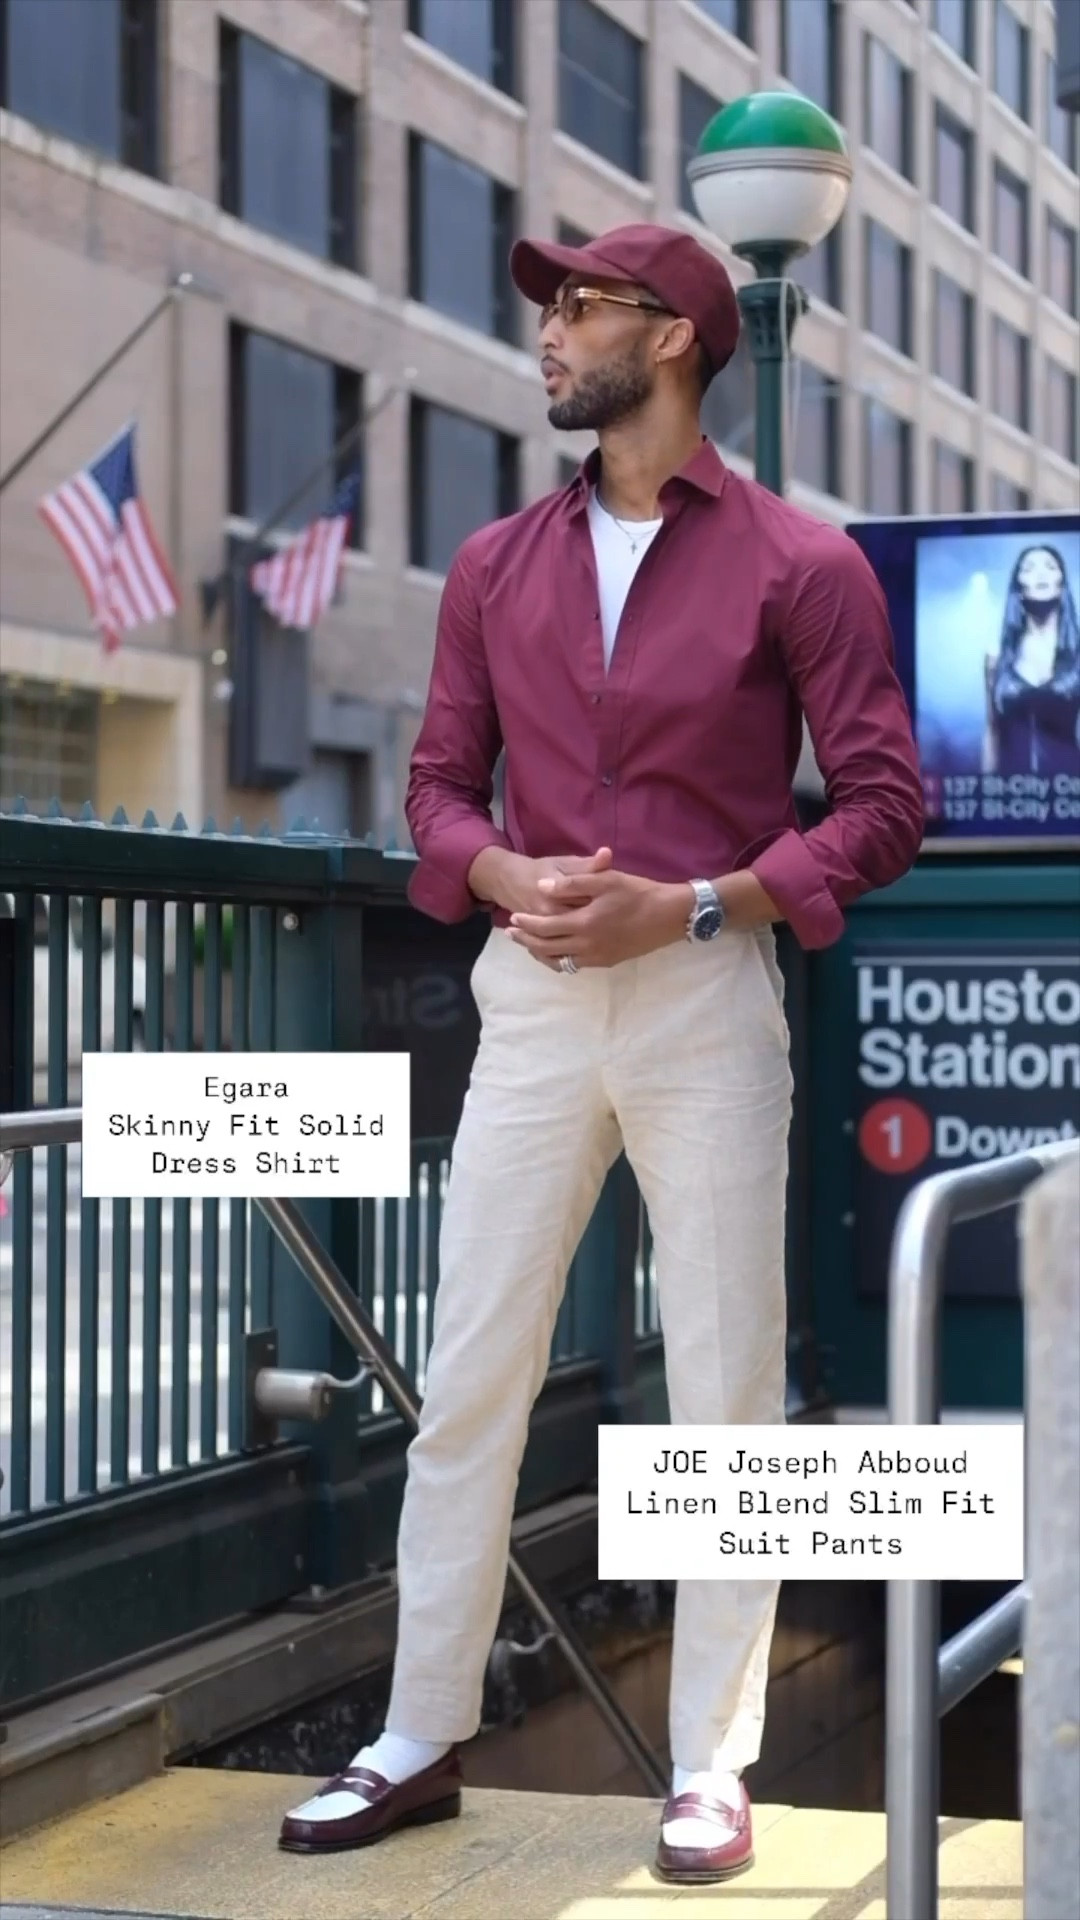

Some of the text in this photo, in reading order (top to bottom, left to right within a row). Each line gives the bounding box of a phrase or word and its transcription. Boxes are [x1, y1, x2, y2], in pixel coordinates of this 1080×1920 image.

[858, 966, 1080, 1025] Housto
[858, 1028, 1080, 1089] Station
[880, 1115, 902, 1158] 1
